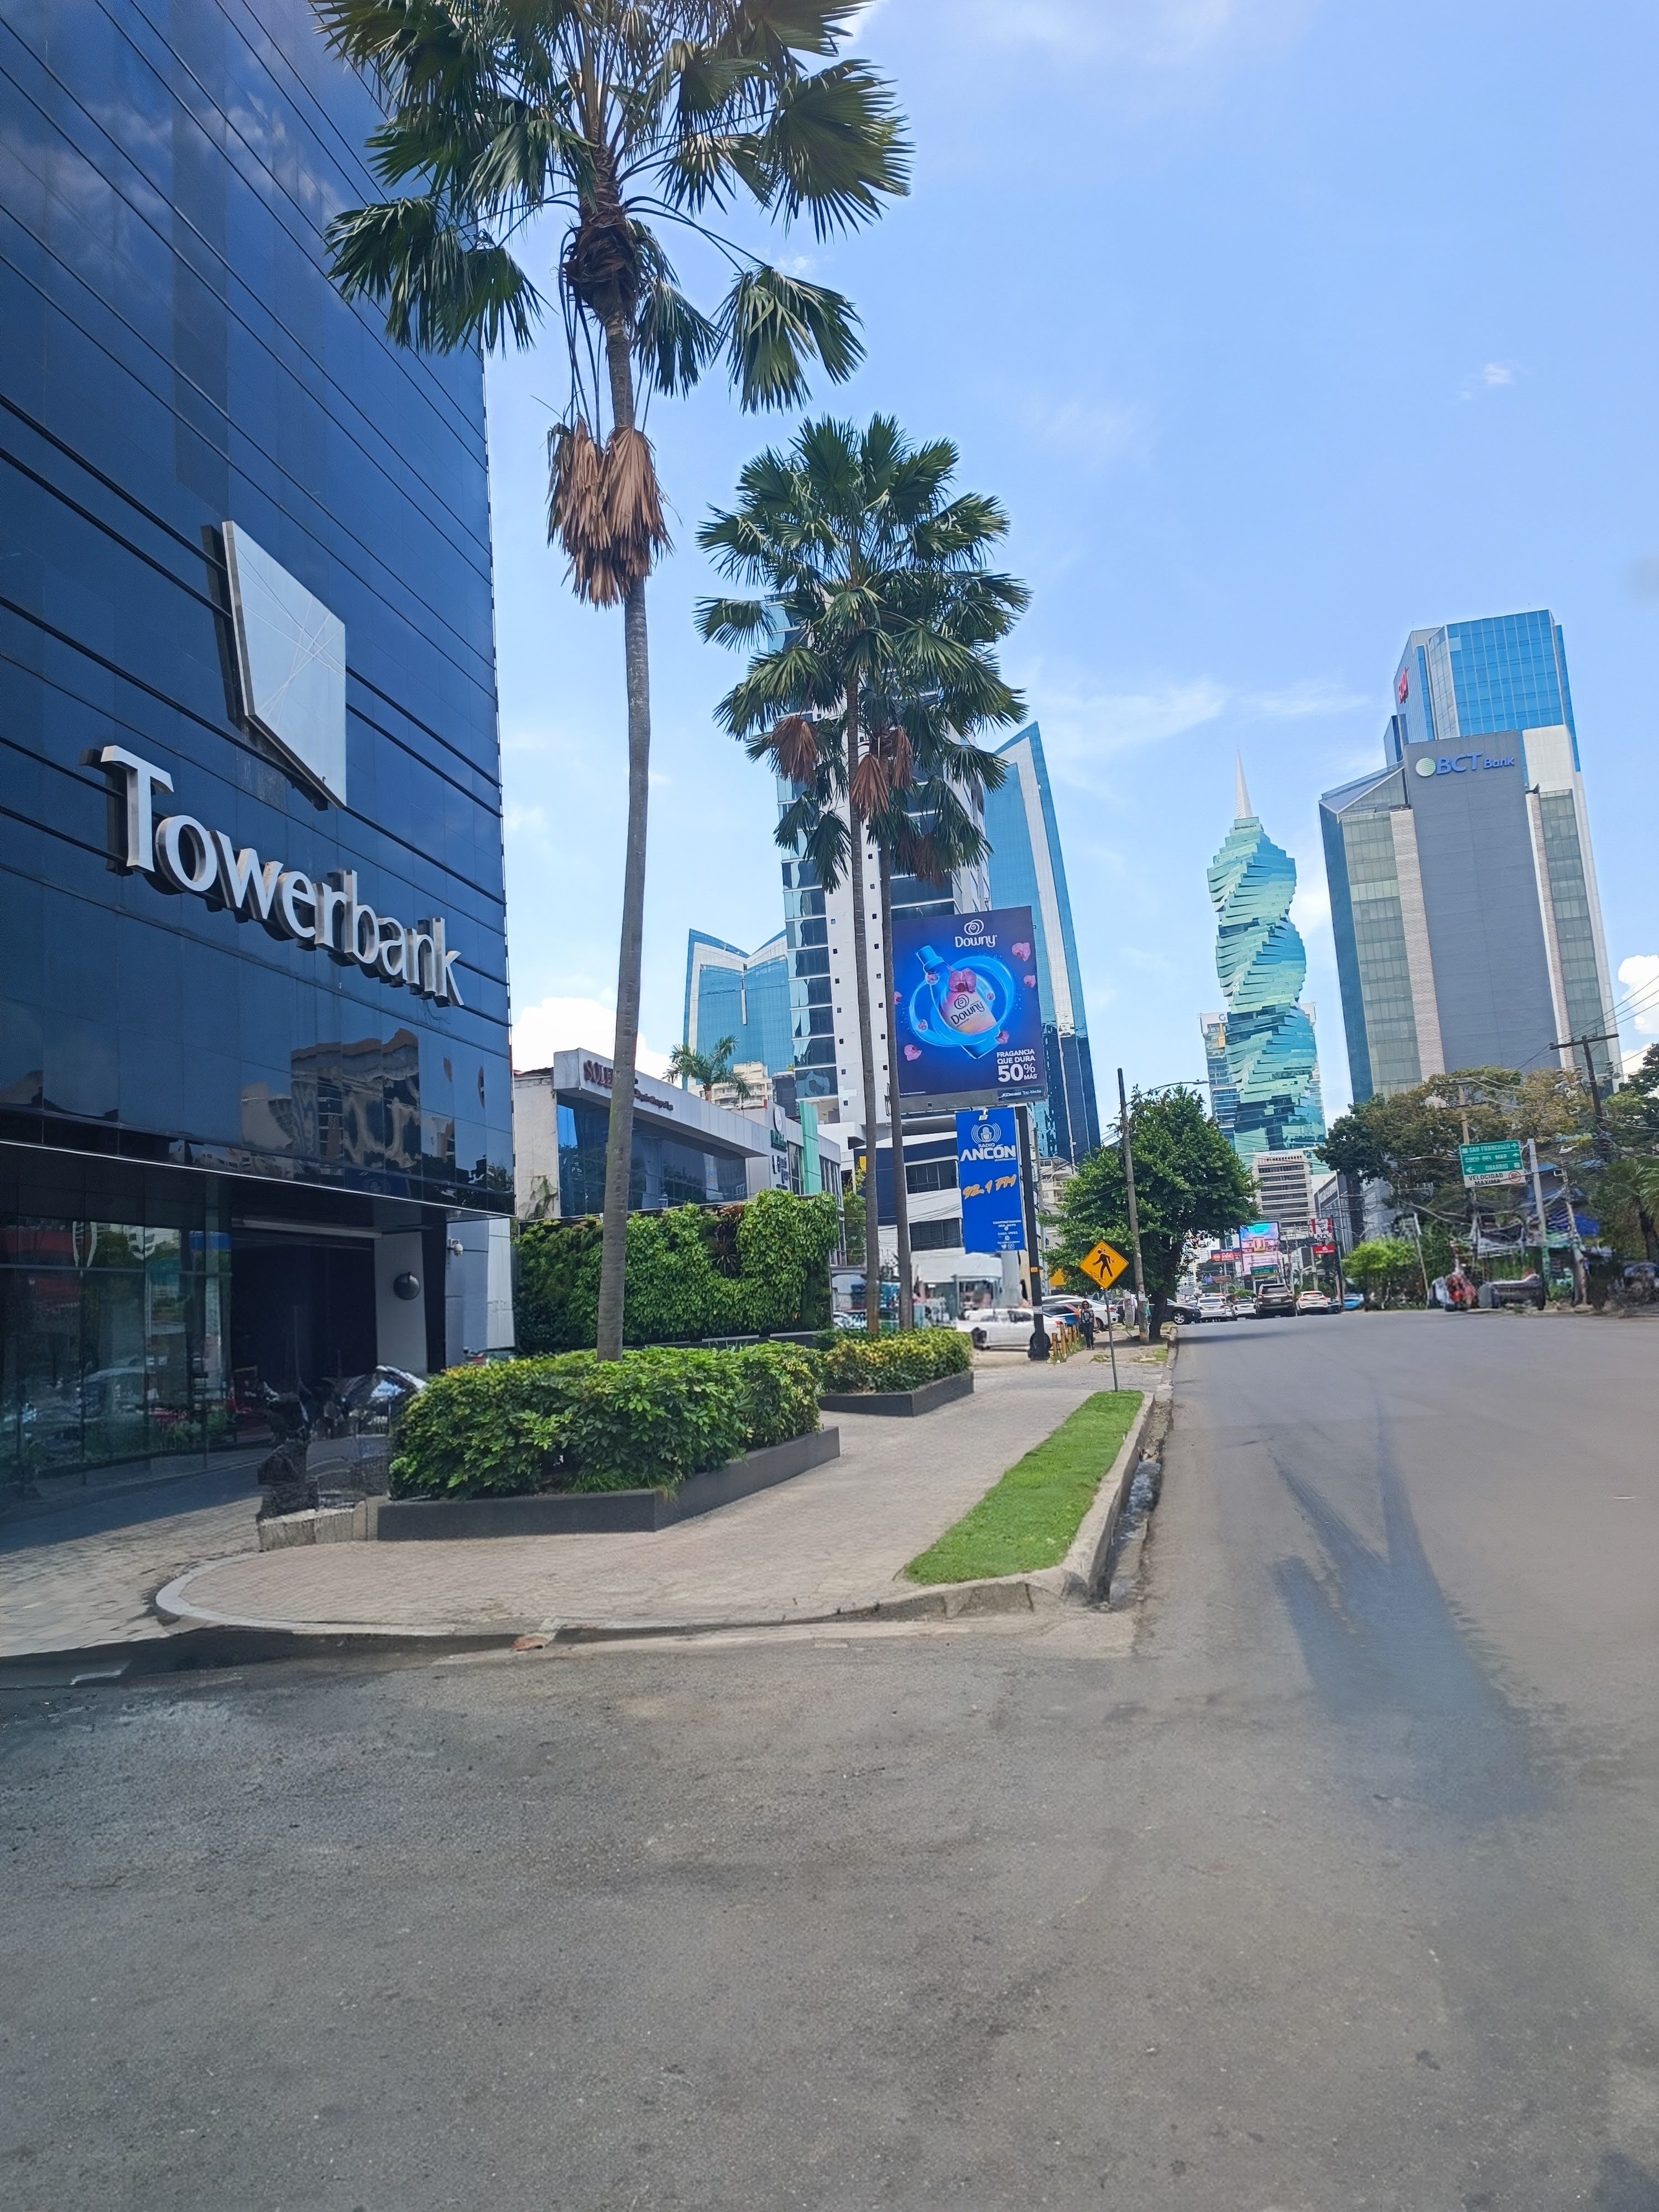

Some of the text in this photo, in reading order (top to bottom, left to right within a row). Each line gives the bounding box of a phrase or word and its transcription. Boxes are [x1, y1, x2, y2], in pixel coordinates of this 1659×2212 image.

[1436, 752, 1515, 775] BCT Bank
[100, 744, 465, 1006] Towerbank
[954, 935, 997, 948] Downy
[951, 1001, 985, 1025] Downy
[997, 1048, 1035, 1058] FRAGANCIA
[1014, 1055, 1035, 1063] DURA
[998, 1062, 1036, 1082] 50%
[960, 1144, 1016, 1162] ANCÓN
[1481, 1143, 1510, 1152] FRANCISCO
[994, 1173, 1017, 1191] FM
[1468, 1172, 1504, 1181] VELOCIDAD
